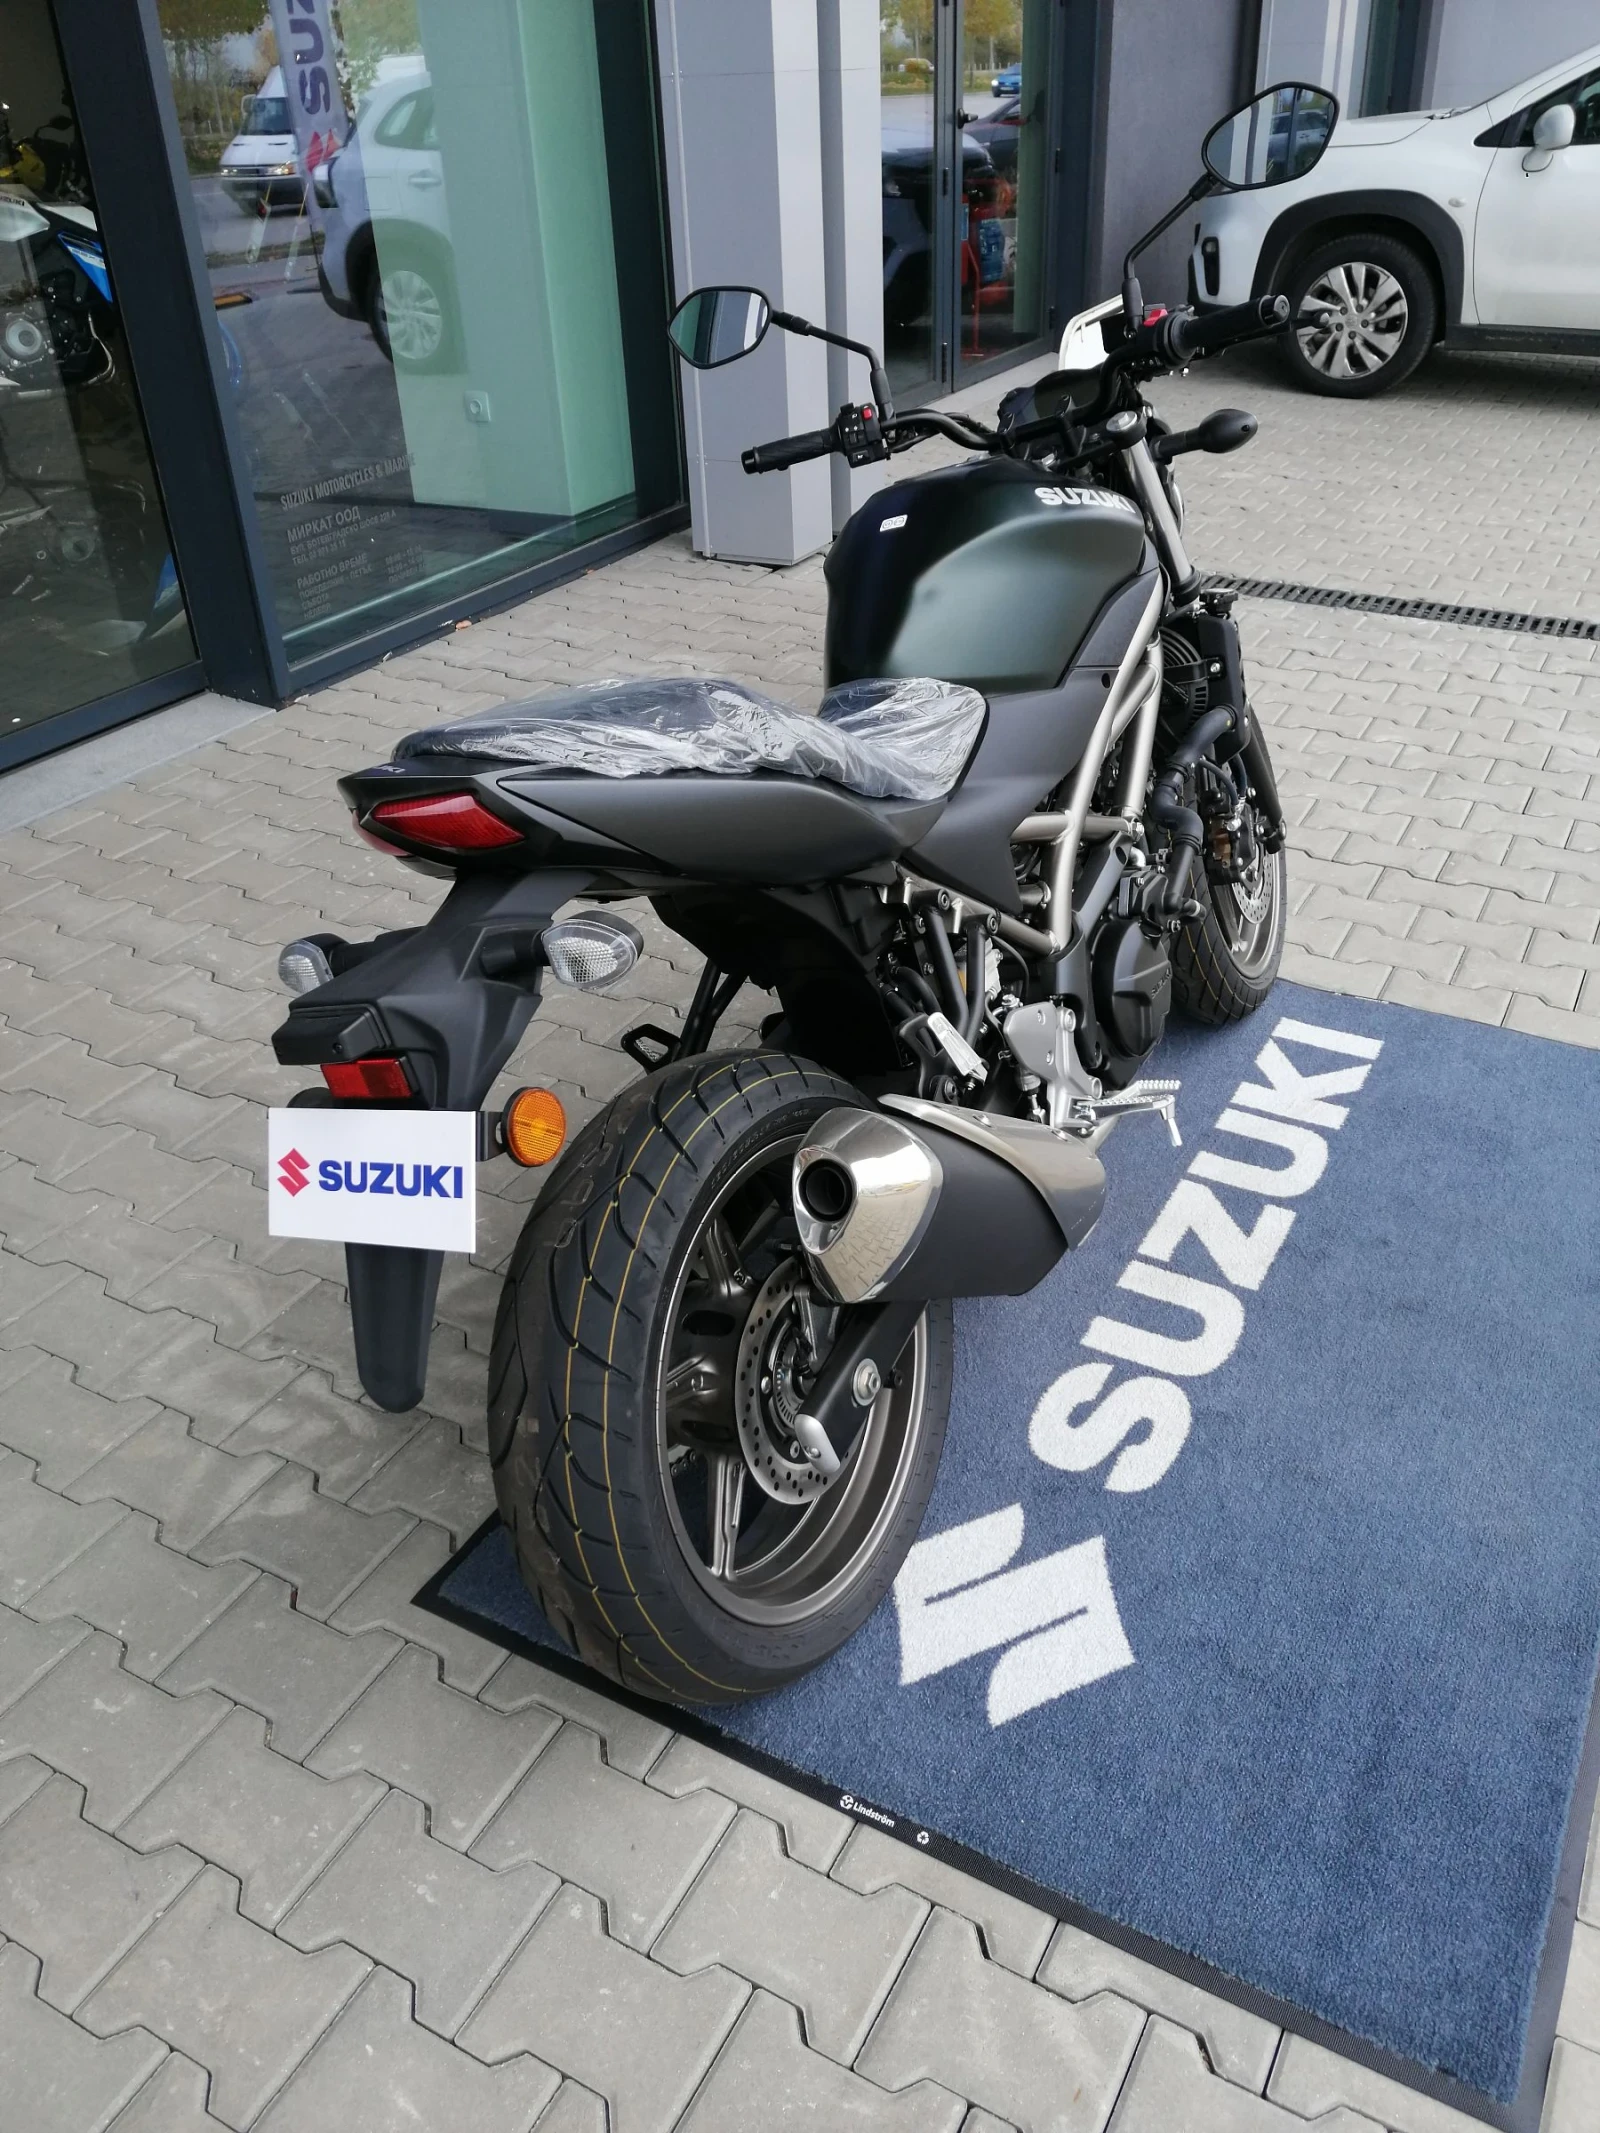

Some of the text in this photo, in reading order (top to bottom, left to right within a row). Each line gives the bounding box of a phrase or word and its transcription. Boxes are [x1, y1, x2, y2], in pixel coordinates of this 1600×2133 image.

[280, 483, 314, 512] SUZUKI
[315, 466, 376, 501] MOTORCYCLES
[1034, 487, 1136, 514] SUZUKI
[287, 505, 361, 543] МИРКАТ ООД
[297, 564, 339, 589] РАБОТНО
[318, 1159, 463, 1199] SUZUKI
[1028, 1016, 1386, 1494] SUZUKI
[853, 1801, 895, 1828] Lindström
